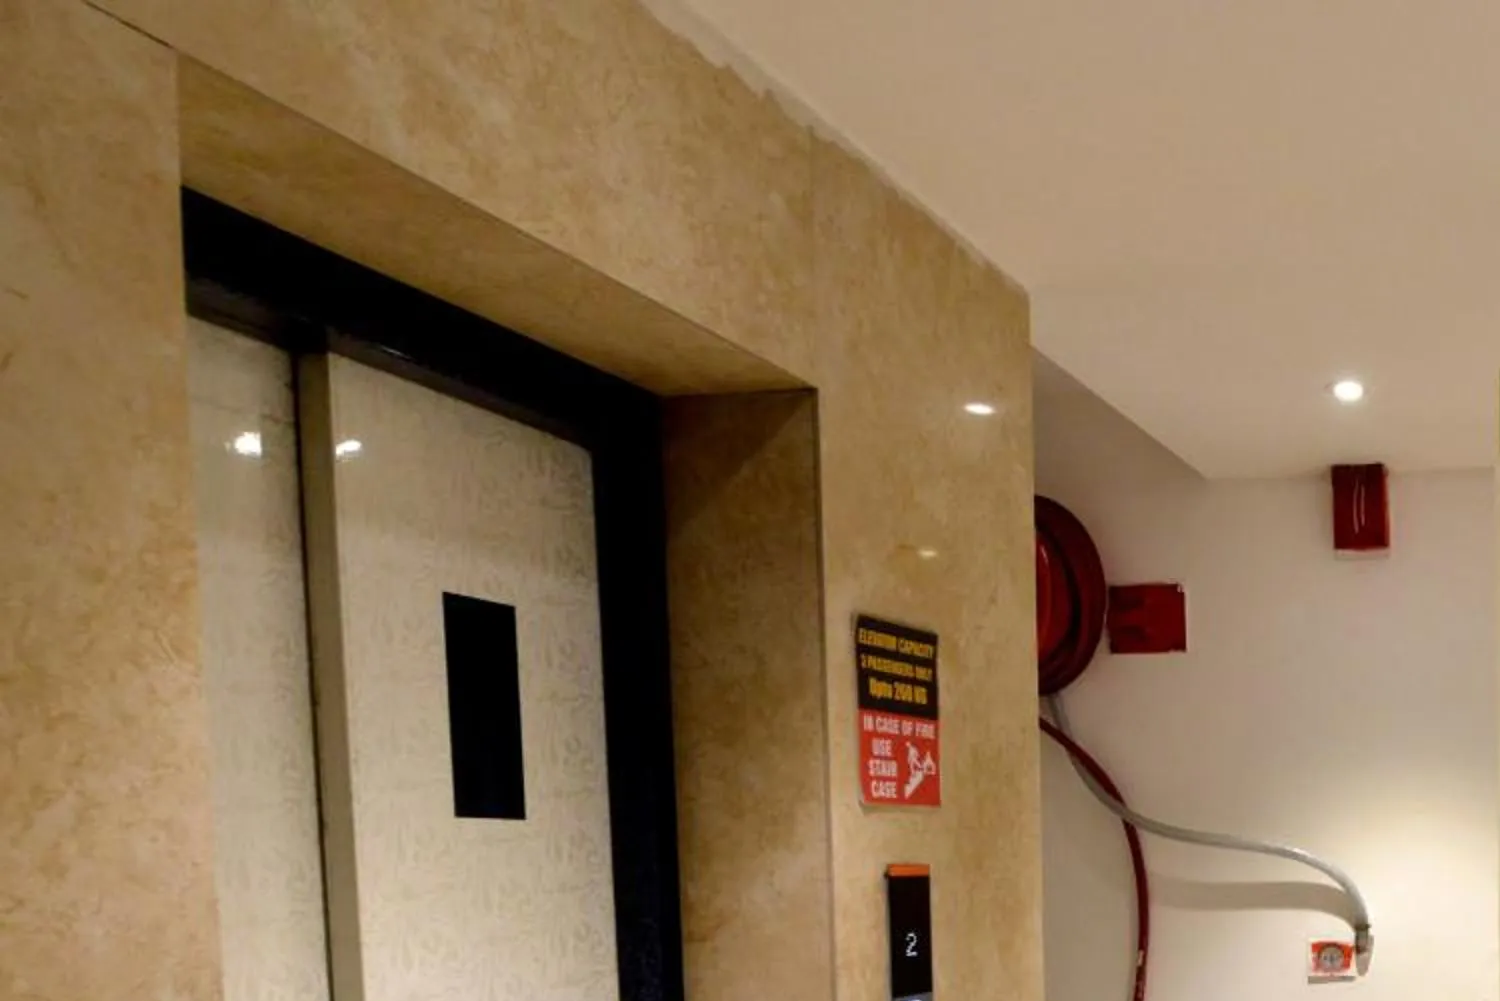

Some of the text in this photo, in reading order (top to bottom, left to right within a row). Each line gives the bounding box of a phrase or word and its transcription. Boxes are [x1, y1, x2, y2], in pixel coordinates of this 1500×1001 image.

[863, 713, 936, 739] IN CASE OF FIRE
[872, 737, 892, 756] USE
[867, 758, 898, 778] STAIR
[872, 780, 898, 799] CASE
[905, 932, 918, 957] 2
